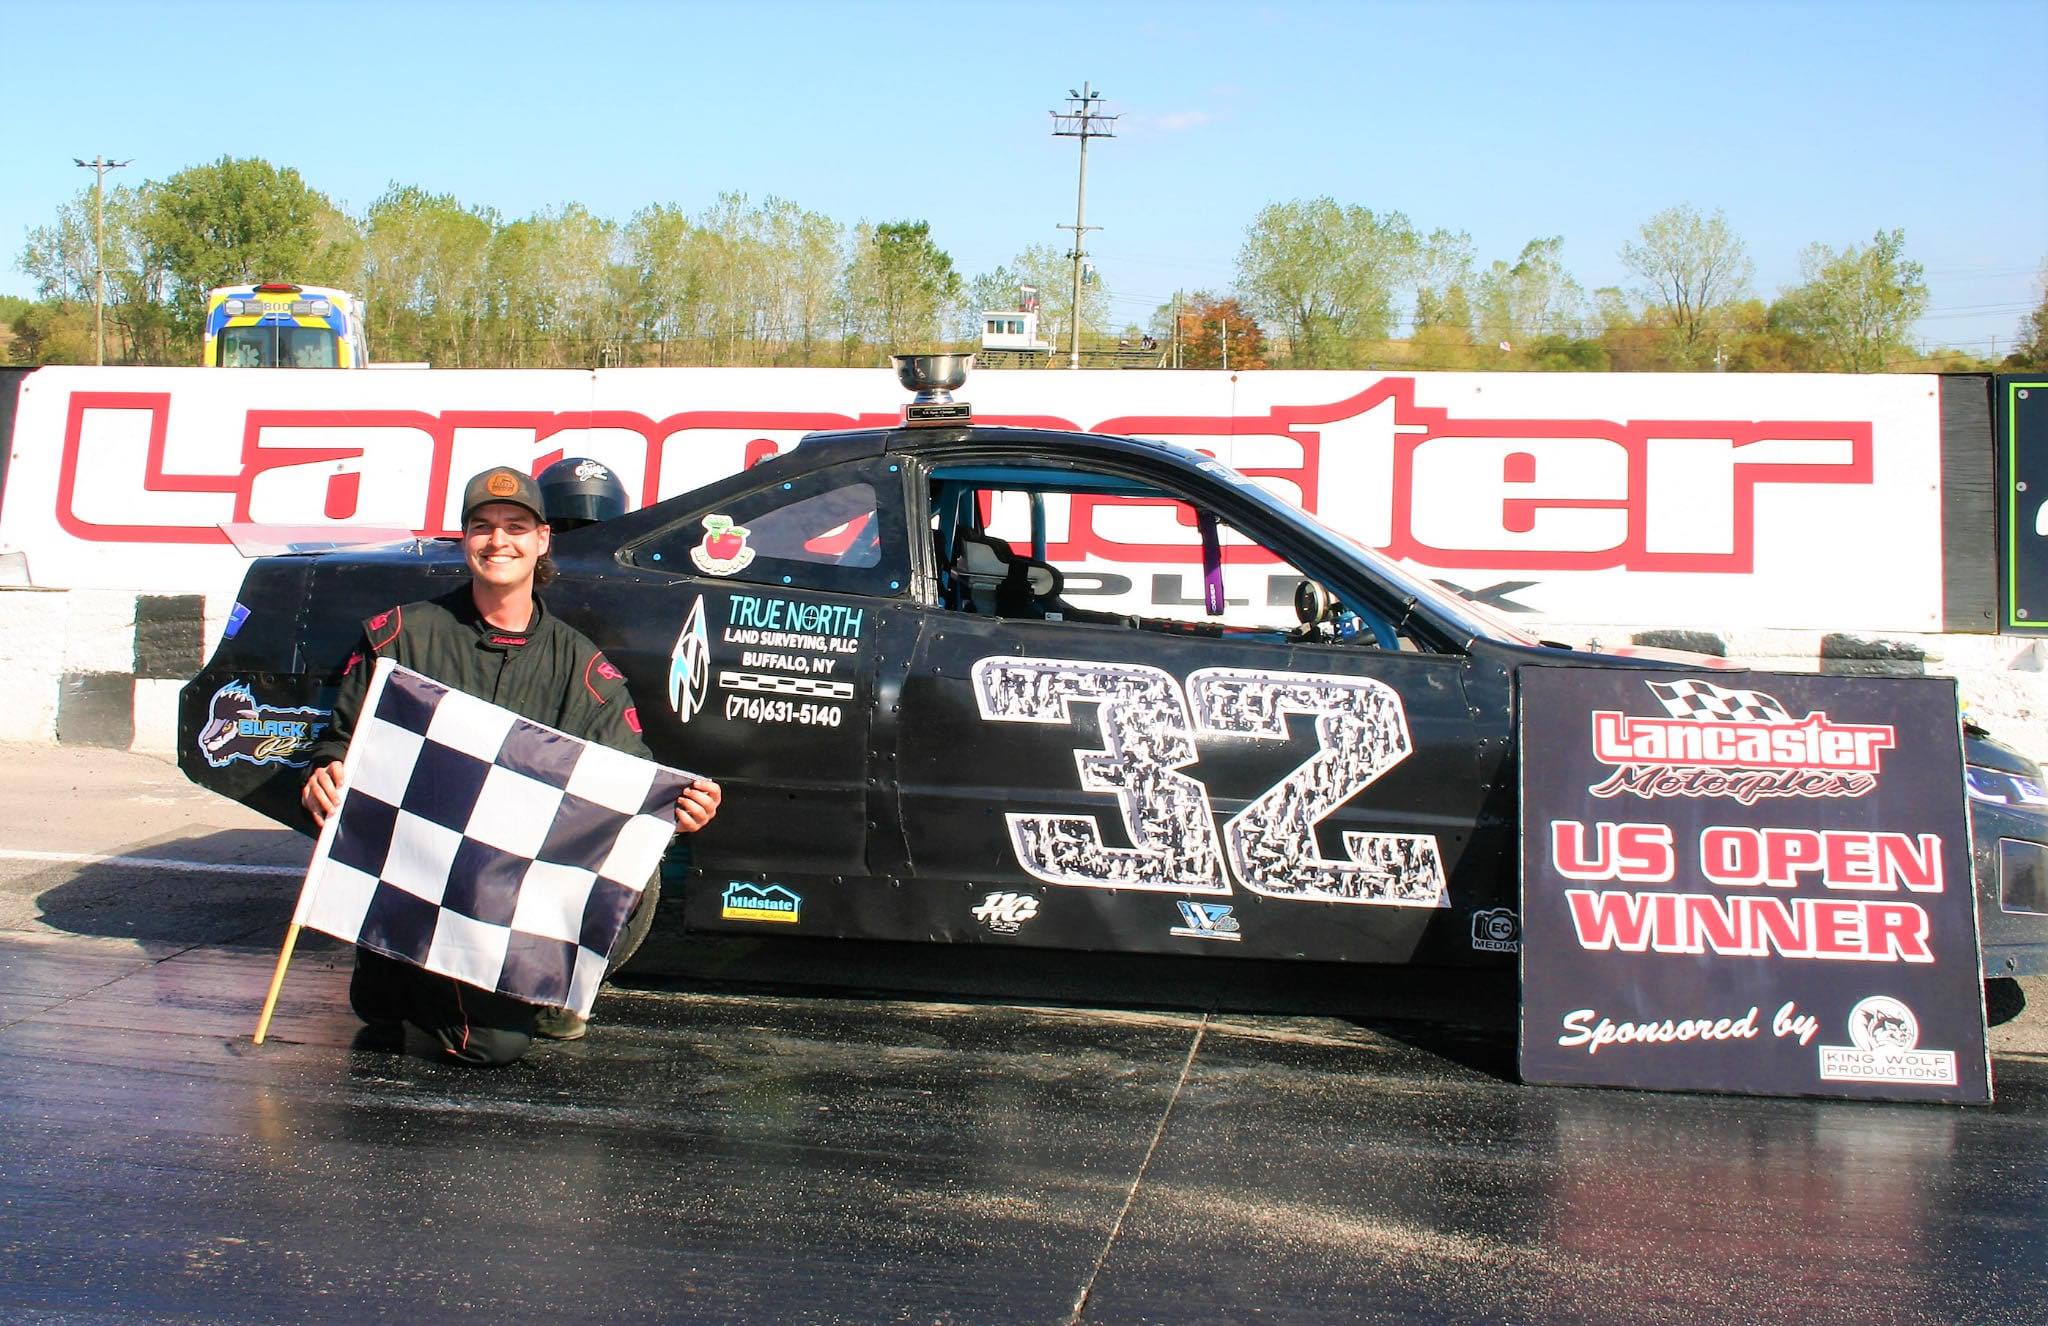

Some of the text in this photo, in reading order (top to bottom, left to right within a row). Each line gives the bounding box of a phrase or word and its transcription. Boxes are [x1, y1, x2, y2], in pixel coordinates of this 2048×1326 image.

[263, 302, 290, 312] 800
[729, 595, 863, 638] TRUE NORTH
[723, 628, 858, 654] LAND SURVEYING, PLLC
[742, 652, 836, 674] BUFFALO, NY
[726, 695, 841, 727] (716)631-5140
[239, 719, 307, 737] BLACK
[1591, 709, 1897, 774] Lancaster
[970, 654, 1453, 909] 32
[1587, 765, 1878, 806] Motorplex
[1550, 819, 1945, 894] US OPEN
[729, 895, 793, 911] Midstate
[1491, 922, 1511, 933] EC
[1564, 889, 1936, 964] WINNER
[1475, 940, 1515, 951] MEDIA
[1556, 1000, 1820, 1056] Sponsored by
[1826, 1053, 1946, 1068] KING WOLF
[1826, 1064, 1949, 1079] PRODUCTIONS
